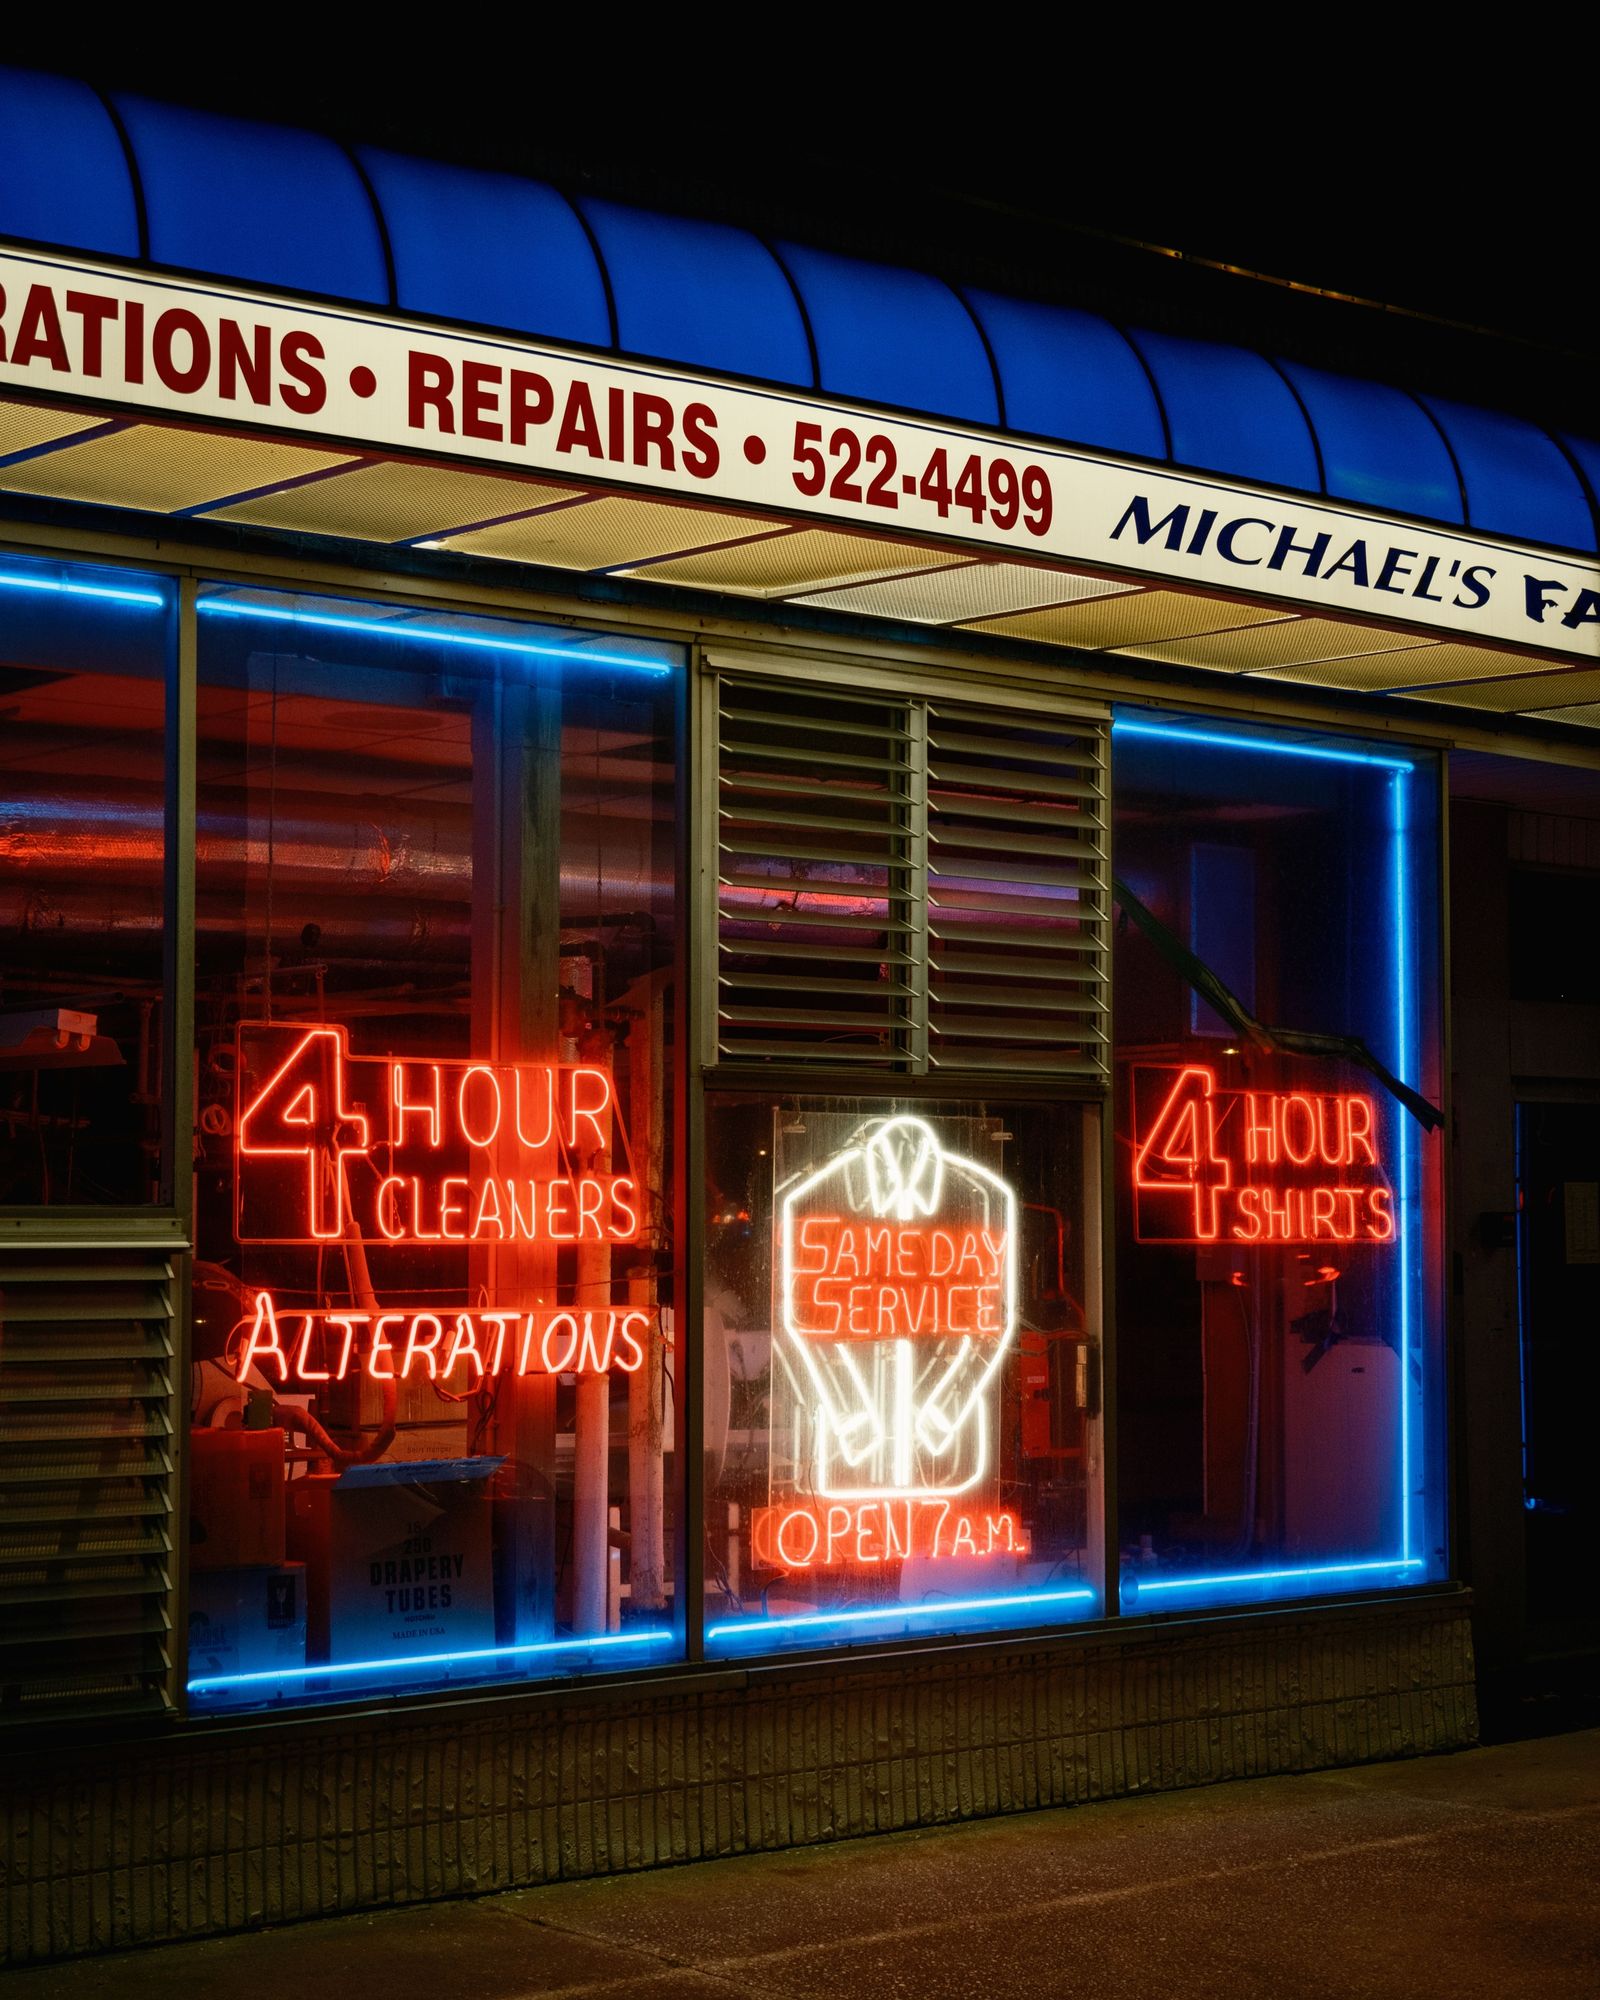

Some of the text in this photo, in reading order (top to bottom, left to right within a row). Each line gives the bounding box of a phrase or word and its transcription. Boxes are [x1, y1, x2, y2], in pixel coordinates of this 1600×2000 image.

[0, 274, 1054, 537] ATIONS REPAIRS 522-4499
[1109, 495, 1497, 609] MICHAEL'S
[238, 1028, 611, 1240] 4 HOUR
[1135, 1068, 1378, 1240] 4 HOUR
[376, 1175, 638, 1241] CLEANERS
[1231, 1186, 1395, 1241] SHIRTS
[790, 1214, 1009, 1279] SAME DAY
[235, 1289, 651, 1384] ALTERATIONS
[797, 1275, 1002, 1337] SERVICE
[776, 1499, 913, 1569] OPEN
[919, 1498, 952, 1561] 7
[370, 1553, 464, 1585] DRAPERY
[385, 1584, 452, 1613] TUBES
